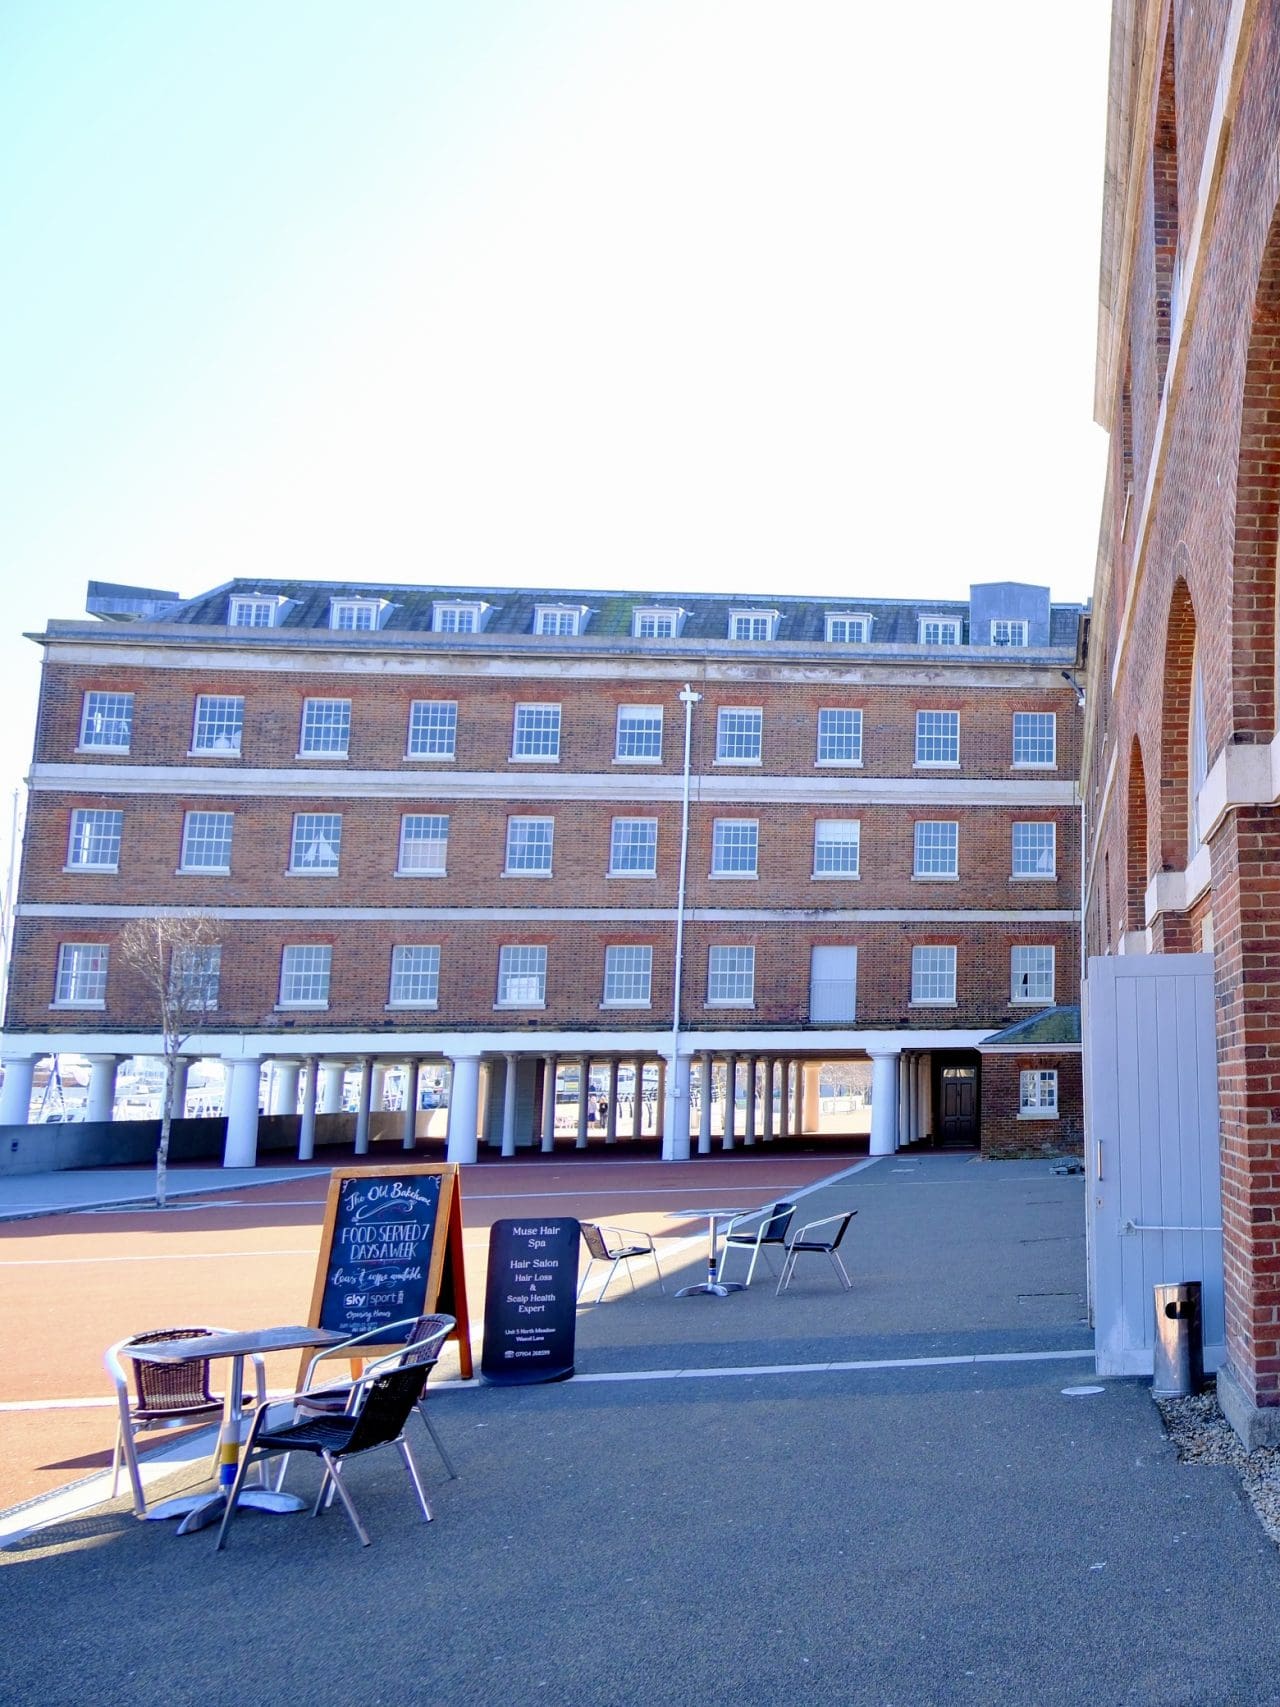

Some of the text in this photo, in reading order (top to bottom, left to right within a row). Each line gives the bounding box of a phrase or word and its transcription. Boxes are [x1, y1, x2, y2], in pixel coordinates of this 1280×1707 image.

[345, 1192, 365, 1212] The
[368, 1185, 389, 1201] Old
[342, 1224, 430, 1244] FOOD SERVED 7
[512, 1226, 561, 1236] Muse Hair
[528, 1238, 546, 1249] Spa
[351, 1242, 418, 1260] DAYS A WEEK
[510, 1258, 559, 1269] Hair Salon
[514, 1273, 553, 1282] Hair Loss
[529, 1283, 537, 1291] &
[346, 1294, 366, 1307] sky
[506, 1293, 556, 1304] Scalp Health
[518, 1304, 545, 1314] Expert
